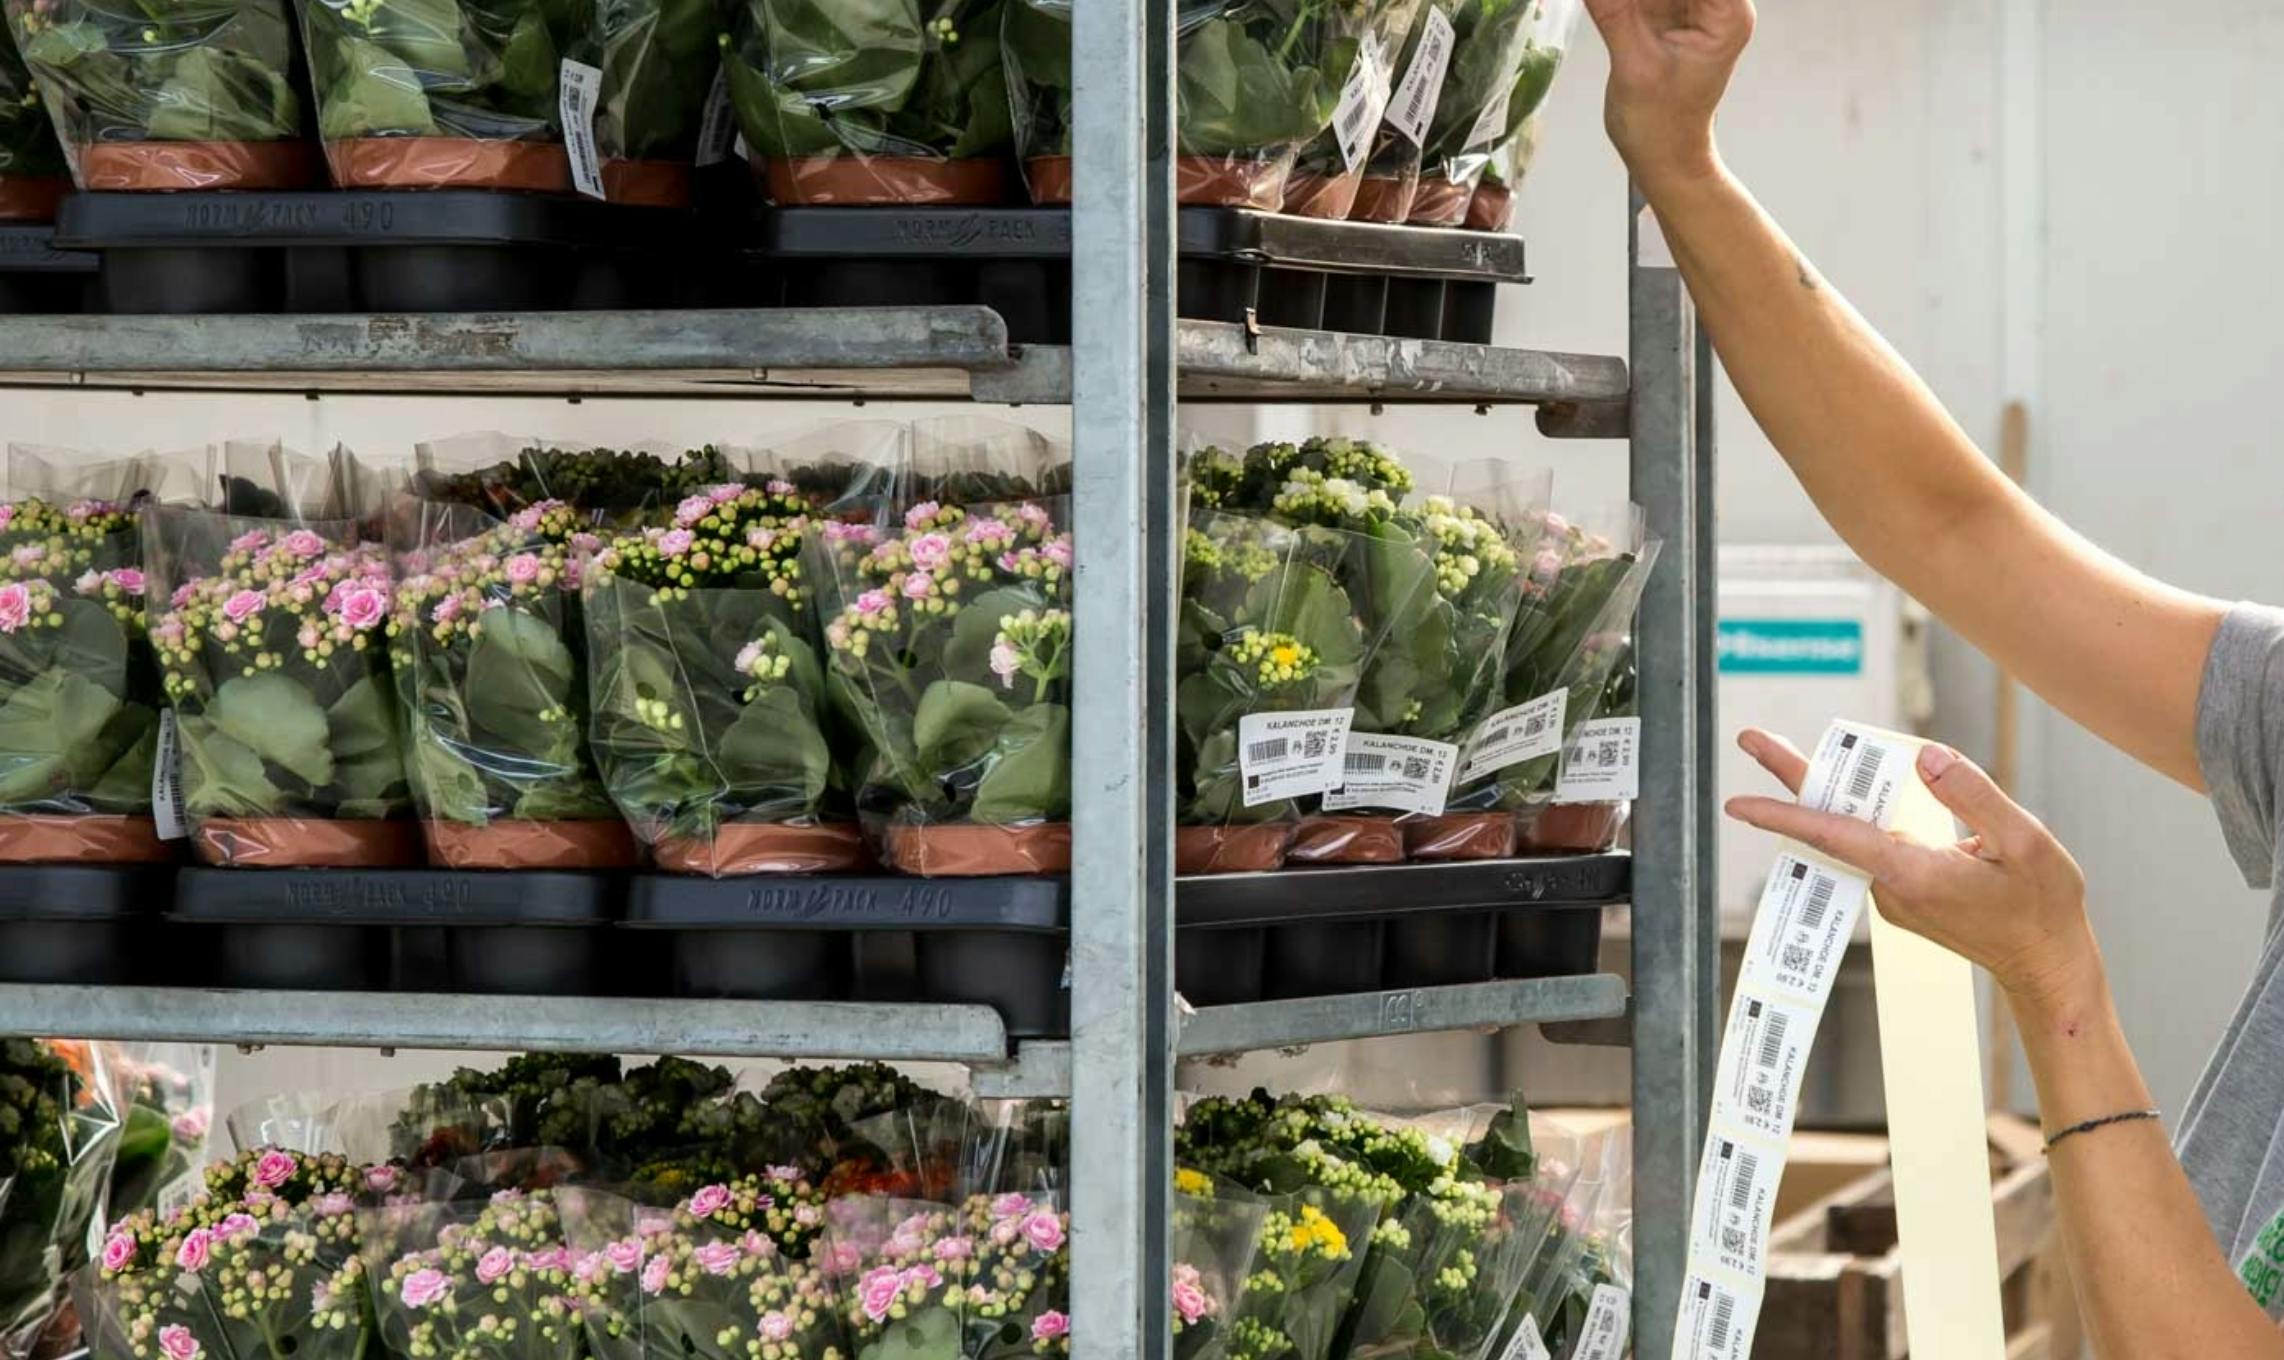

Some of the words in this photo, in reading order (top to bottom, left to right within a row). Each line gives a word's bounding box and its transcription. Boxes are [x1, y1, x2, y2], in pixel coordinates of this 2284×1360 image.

[342, 201, 394, 230] 490
[1266, 719, 1317, 730] KALANCHOE
[1334, 716, 1344, 725] 12
[1362, 740, 1418, 751] KALANCHOE
[1438, 750, 1448, 758] 12
[748, 888, 801, 911] NORM
[832, 888, 878, 912] PACK
[902, 887, 951, 917] 490
[1819, 910, 1844, 963] KALANCHOE
[1778, 1046, 1797, 1104] KALANCHOE
[1750, 1187, 1766, 1244] KALANCHOE
